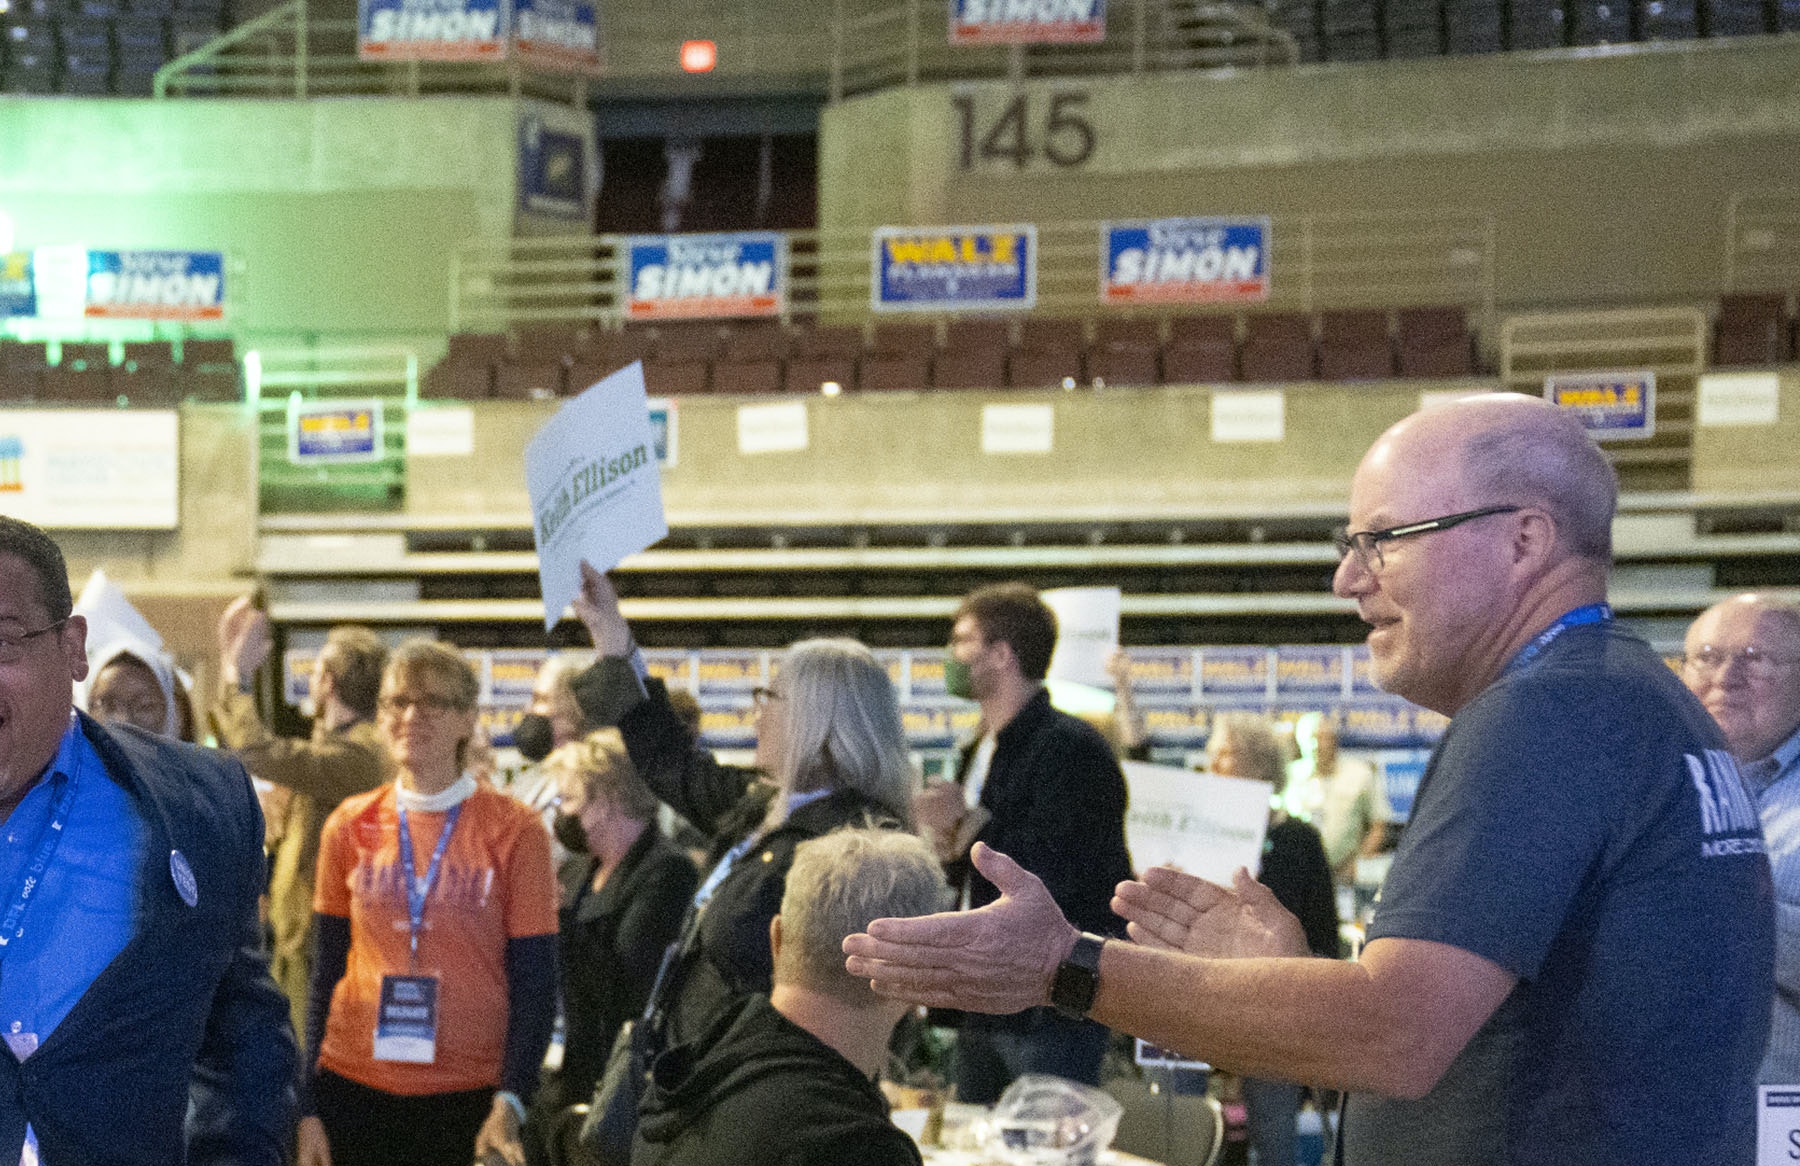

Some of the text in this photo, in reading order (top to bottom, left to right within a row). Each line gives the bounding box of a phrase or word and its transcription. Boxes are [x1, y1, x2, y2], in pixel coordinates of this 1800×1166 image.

[371, 10, 496, 41] SIMON
[951, 91, 1098, 172] 145
[889, 234, 1016, 264] WALZ
[1114, 246, 1261, 284] SIMON
[90, 272, 219, 305] SIMON
[636, 262, 772, 299] SIMON
[572, 443, 648, 506] Ellison
[3, 901, 26, 931] DFL
[20, 875, 38, 900] vote
